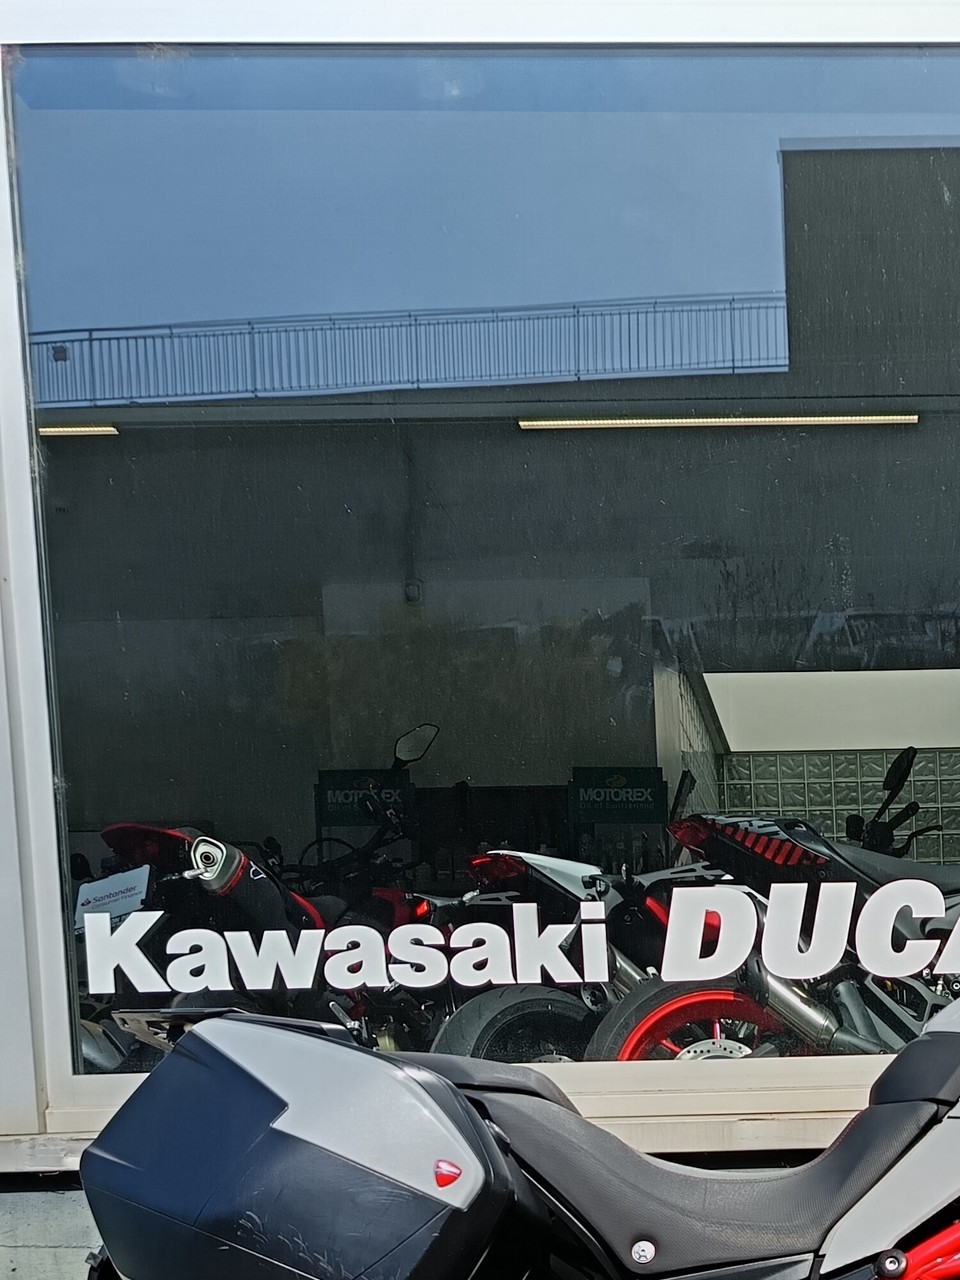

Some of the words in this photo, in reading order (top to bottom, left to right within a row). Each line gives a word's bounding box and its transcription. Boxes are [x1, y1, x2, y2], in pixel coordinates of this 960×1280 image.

[327, 789, 401, 804] MOTEX
[579, 788, 653, 802] MOTOREX
[93, 885, 138, 904] Santander
[83, 901, 610, 995] Kawasaki
